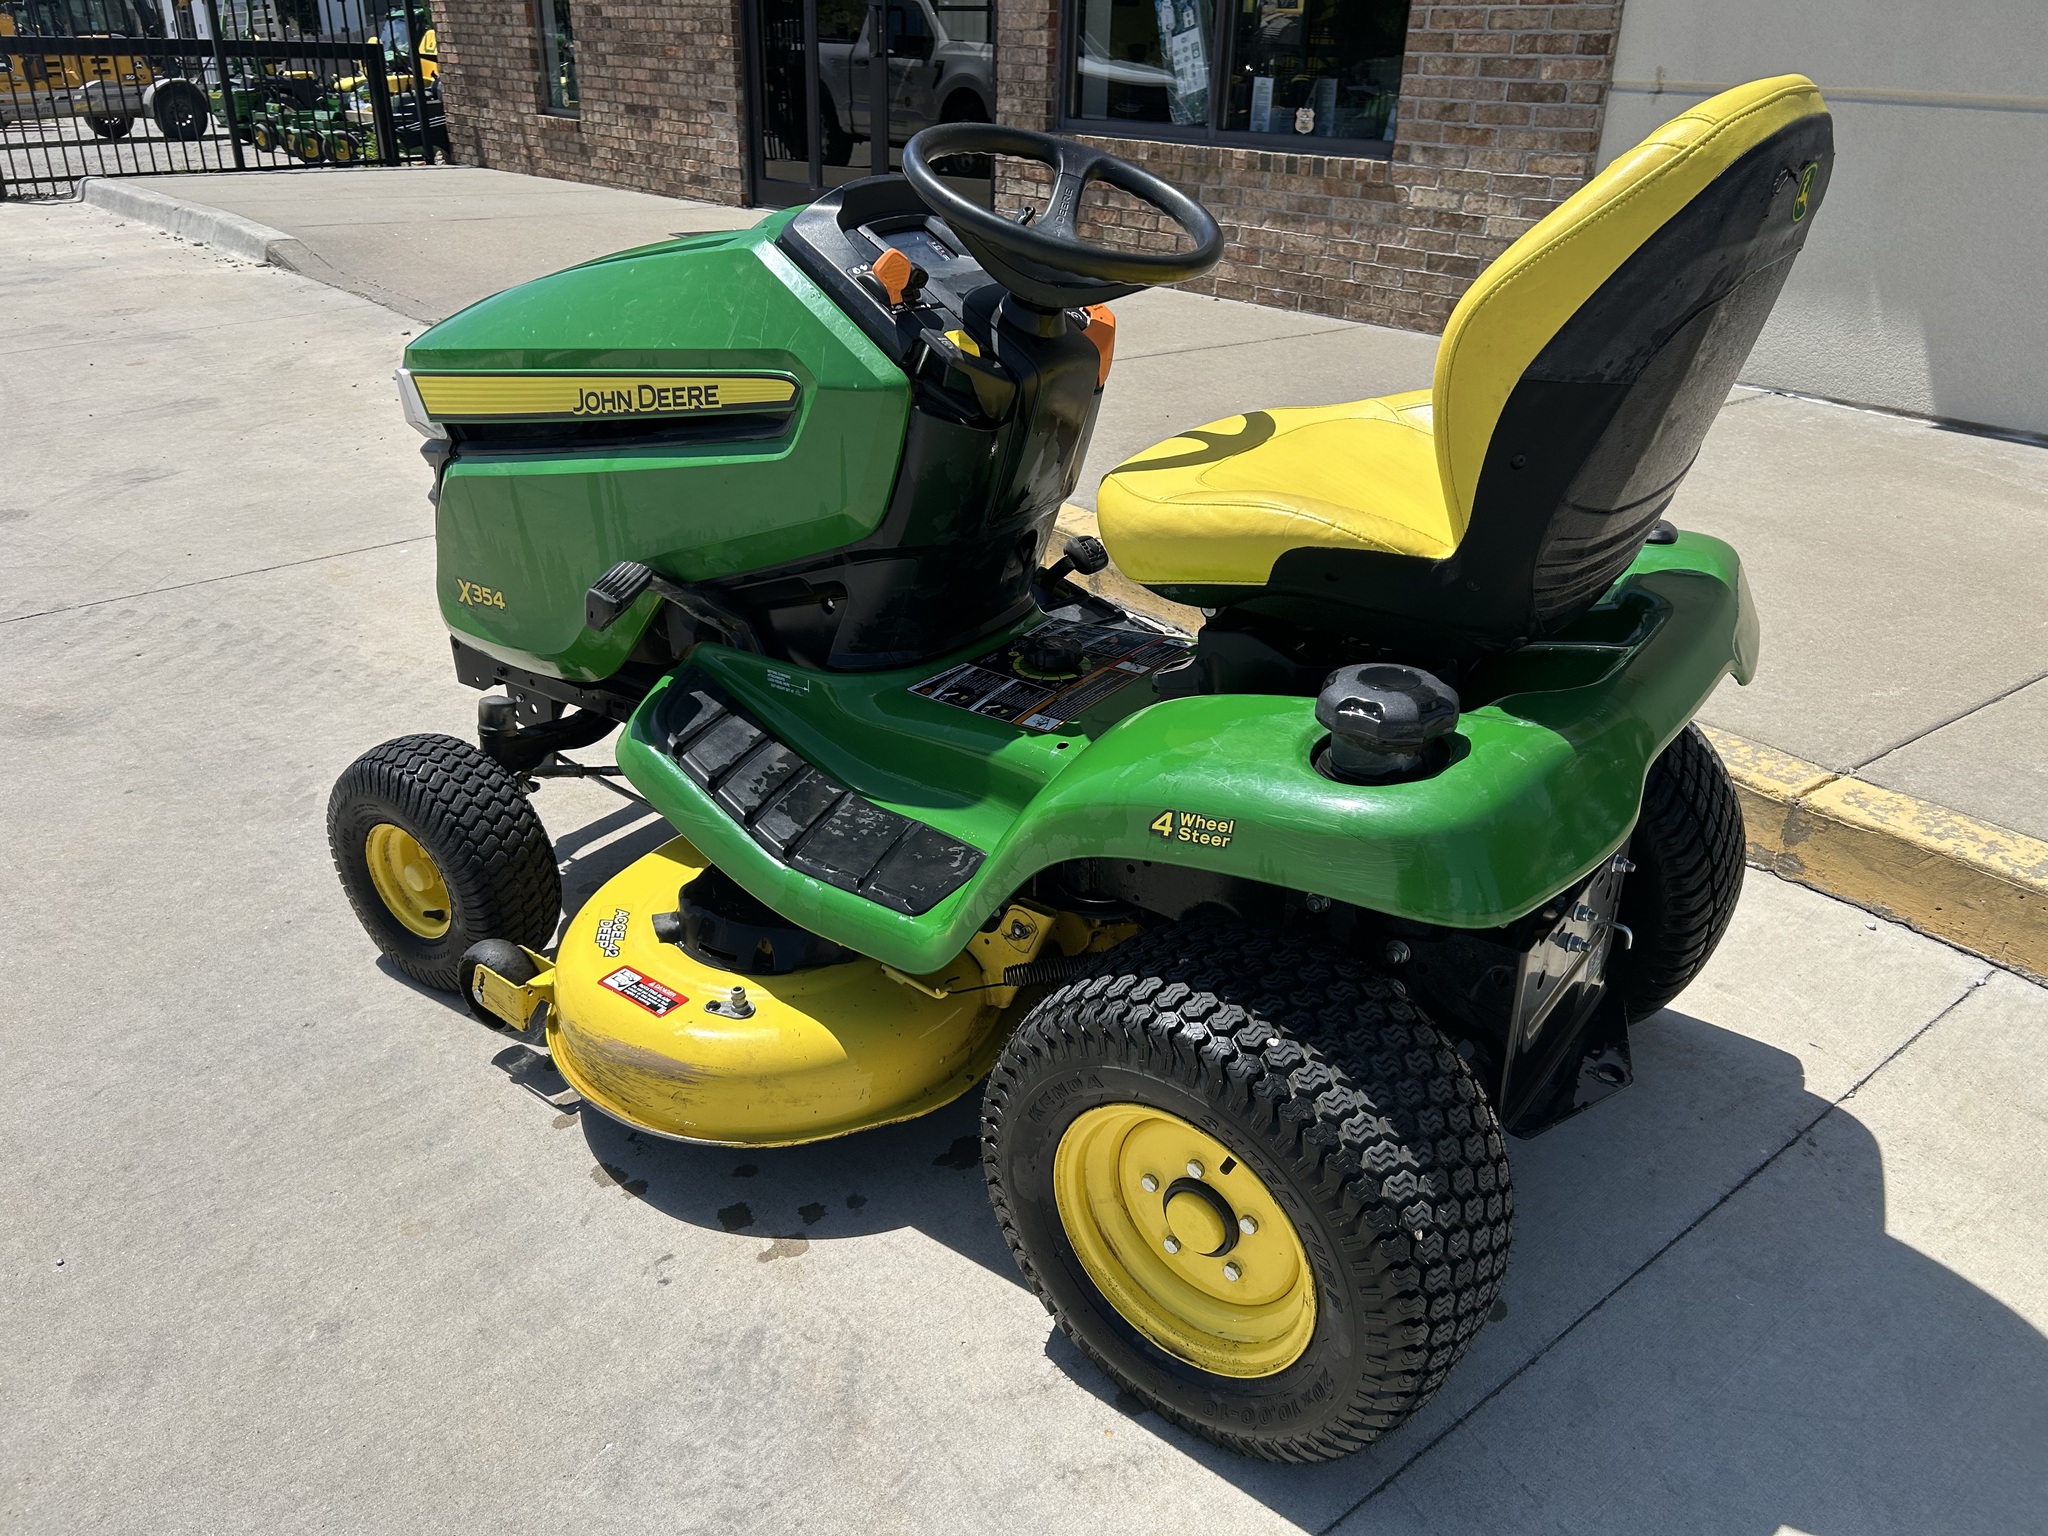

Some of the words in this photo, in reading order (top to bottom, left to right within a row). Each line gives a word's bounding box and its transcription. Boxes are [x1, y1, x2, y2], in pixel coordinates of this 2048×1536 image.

[1055, 187, 1074, 225] DEERE
[573, 388, 634, 414] JOHN
[638, 384, 721, 411] DEERE
[456, 578, 506, 610] X354
[1151, 811, 1173, 837] 4
[1178, 827, 1231, 848] Steer
[1180, 812, 1234, 834] Wheel
[596, 919, 614, 948] DEEP
[654, 983, 677, 998] DANGER
[1028, 1072, 1104, 1124] KENDA
[1200, 1114, 1300, 1211] SUPER
[1301, 1221, 1344, 1315] TURF
